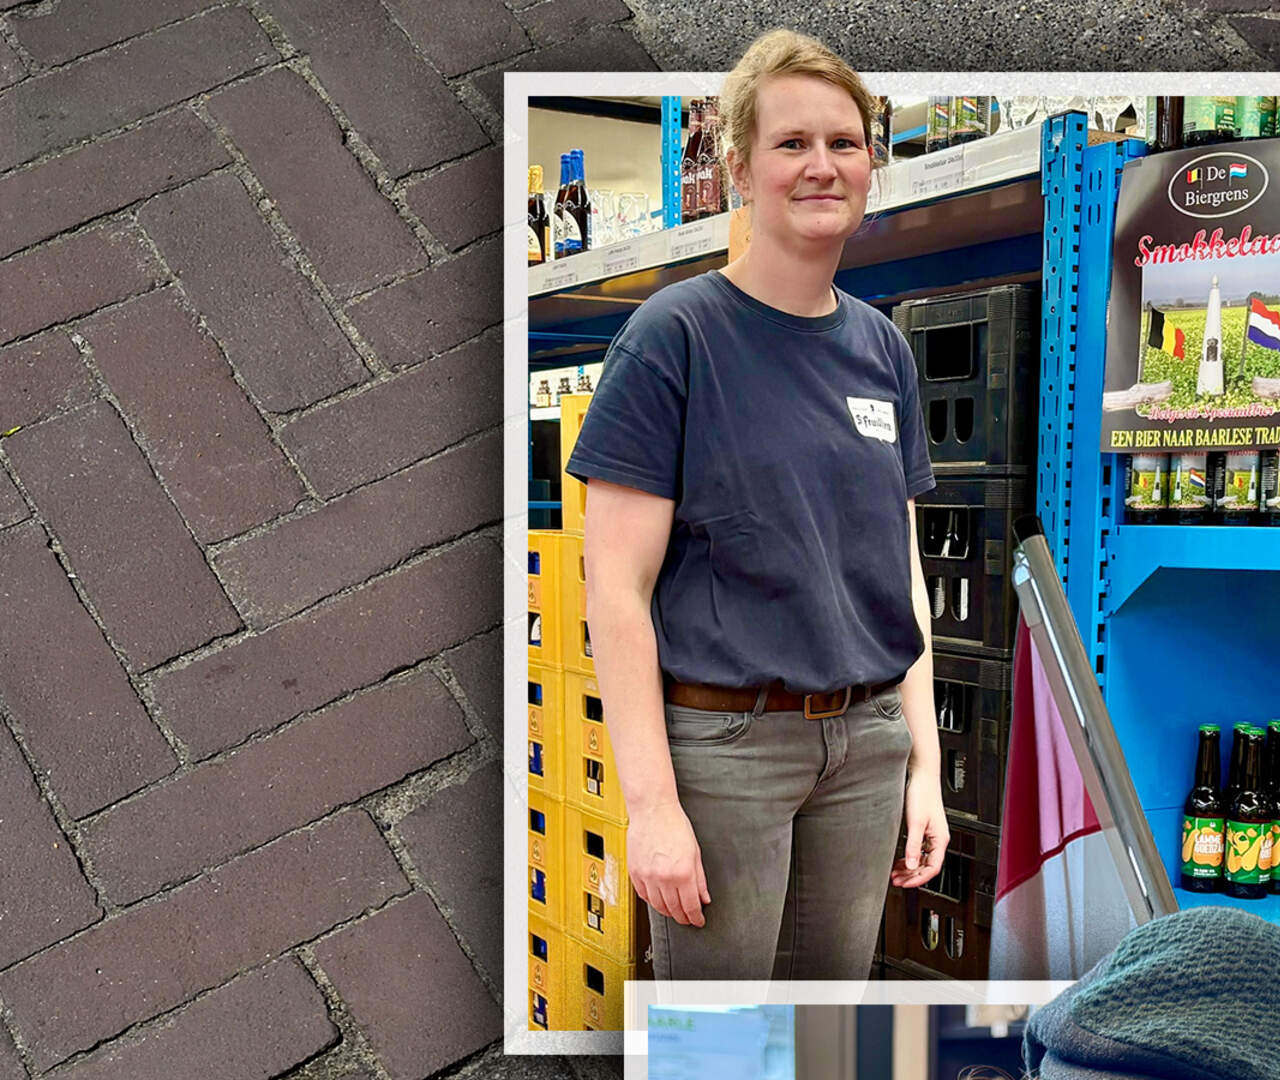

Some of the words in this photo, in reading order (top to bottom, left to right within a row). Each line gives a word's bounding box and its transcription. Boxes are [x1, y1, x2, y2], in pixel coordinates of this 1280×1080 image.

[1206, 166, 1226, 182] De
[1184, 188, 1249, 208] Biergrens
[1110, 430, 1133, 448] EEN
[1135, 430, 1161, 448] BIER
[1162, 429, 1194, 447] NAAR
[1195, 427, 1251, 447] BAARLESE
